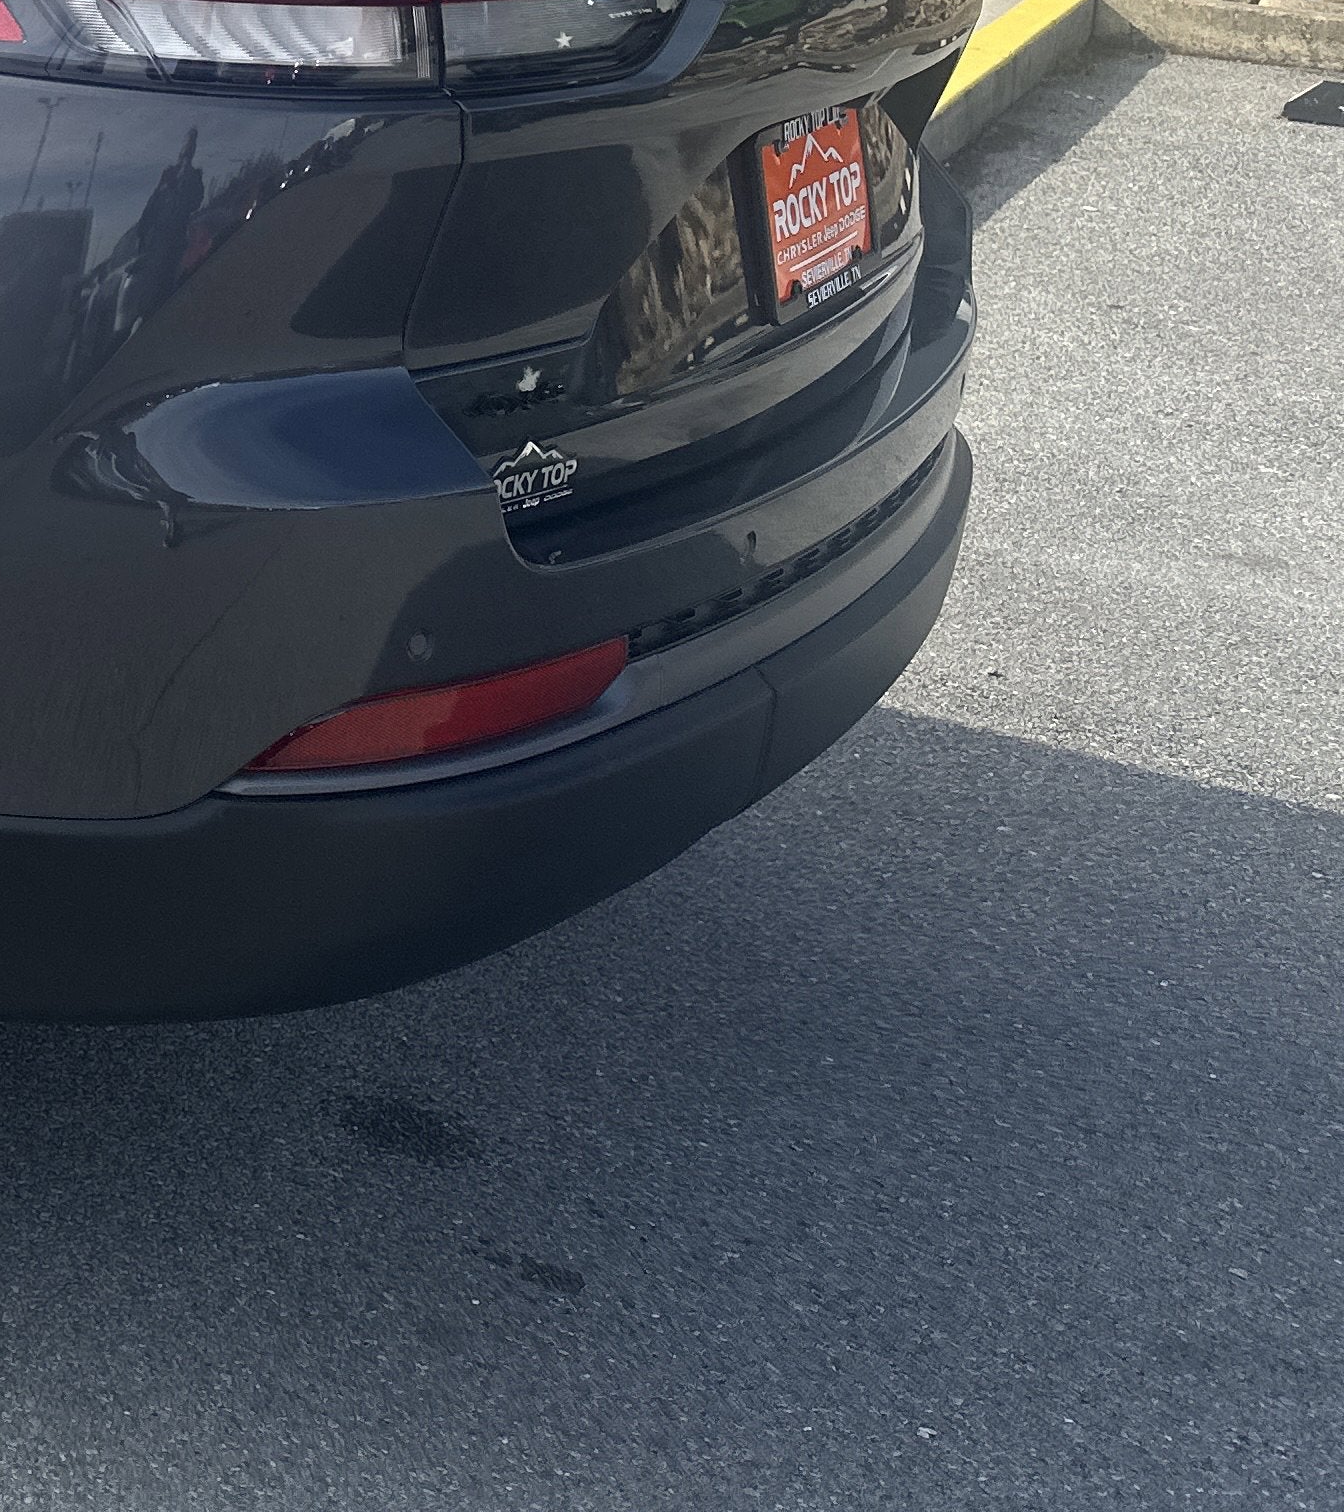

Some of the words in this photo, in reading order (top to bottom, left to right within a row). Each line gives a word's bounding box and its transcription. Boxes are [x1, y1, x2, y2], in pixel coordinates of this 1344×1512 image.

[784, 112, 811, 142] ROCKY
[773, 177, 828, 242] ROCKY
[829, 162, 861, 211] TOP
[777, 232, 823, 265] CHRYSLER
[838, 205, 865, 231] DODGE
[541, 459, 577, 488] TOP
